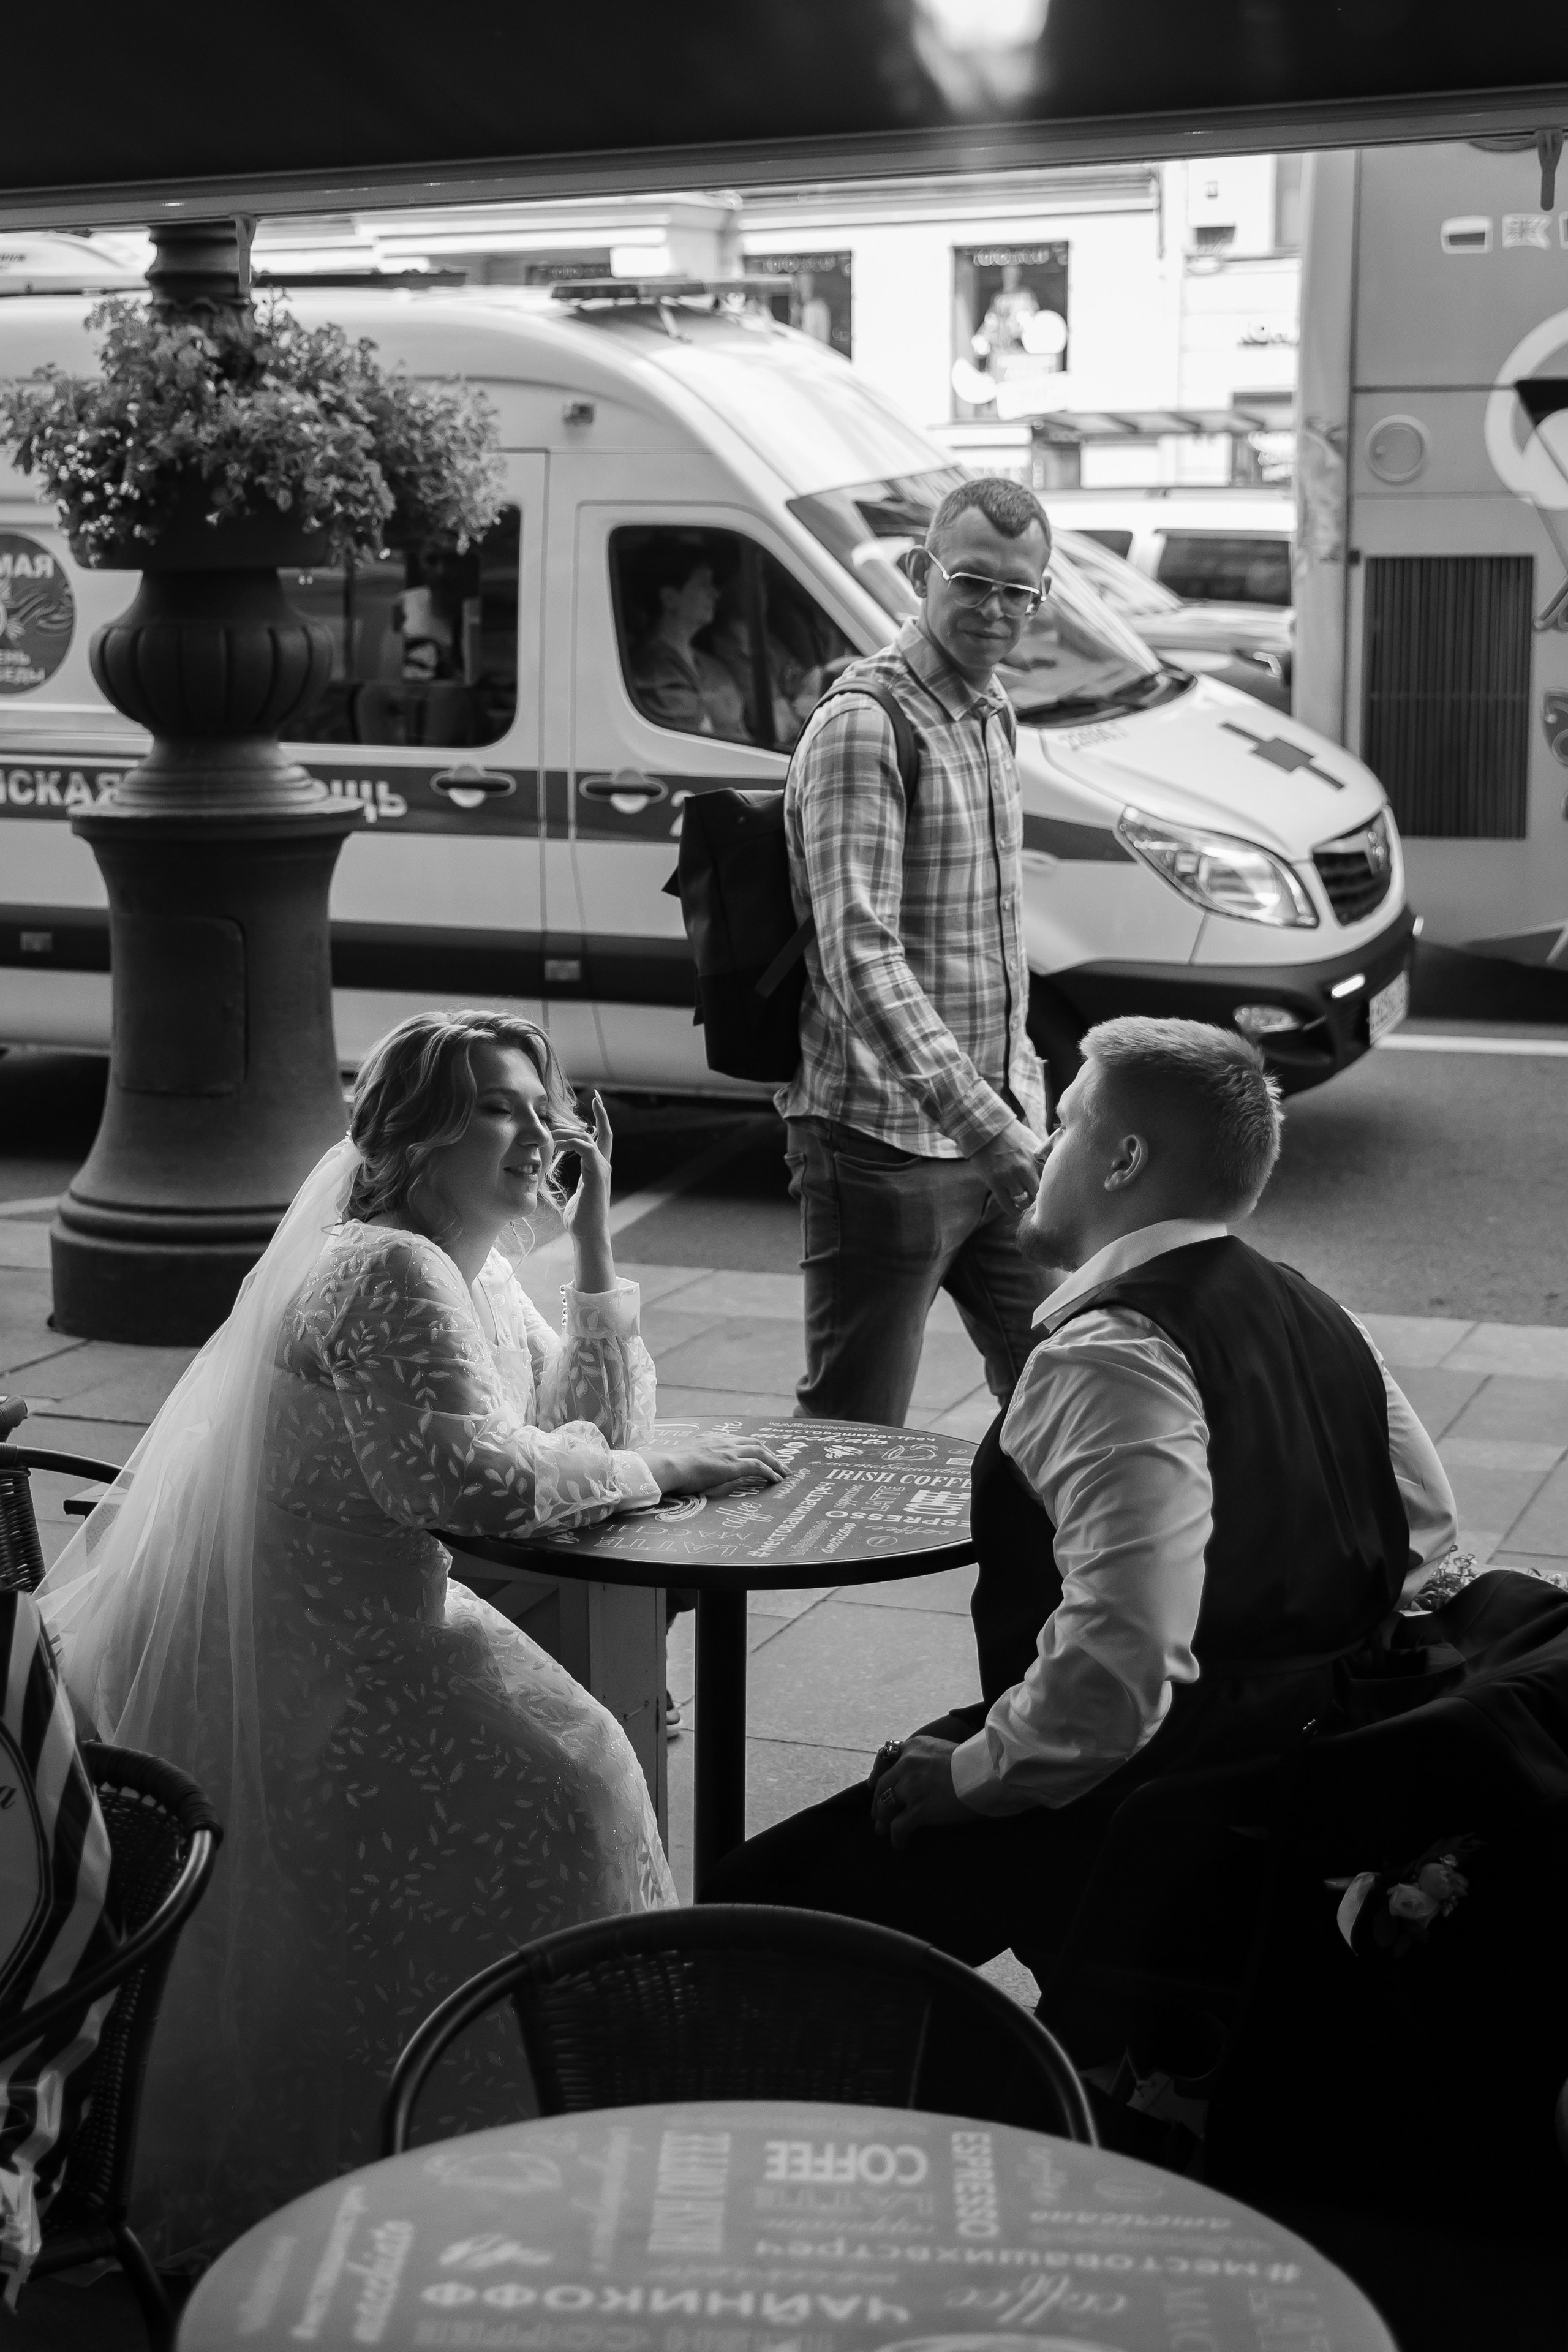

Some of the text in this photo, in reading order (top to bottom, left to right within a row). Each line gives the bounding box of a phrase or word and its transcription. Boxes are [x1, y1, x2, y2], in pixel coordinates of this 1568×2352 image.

[750, 1433, 889, 1446] macchiato
[758, 1427, 937, 1442] #местовашихвстреч
[825, 1468, 972, 1489] IRISH COFFE
[861, 1485, 907, 1512] LATTE
[715, 1501, 774, 1529] coffee
[747, 1481, 835, 1558] #местовашихвстреч
[824, 1510, 971, 1526] ESPRESSO
[821, 1522, 858, 1554] americano
[865, 1525, 951, 1536] coffee
[594, 1536, 739, 1557] LATTE
[763, 2139, 929, 2184] COFFEE
[951, 2131, 1000, 2241] ESPRESSO
[1030, 2208, 1232, 2231] americano
[754, 2237, 1302, 2284] #местовашихвстреч
[422, 2282, 911, 2326] ЧАЙНИКОФФ
